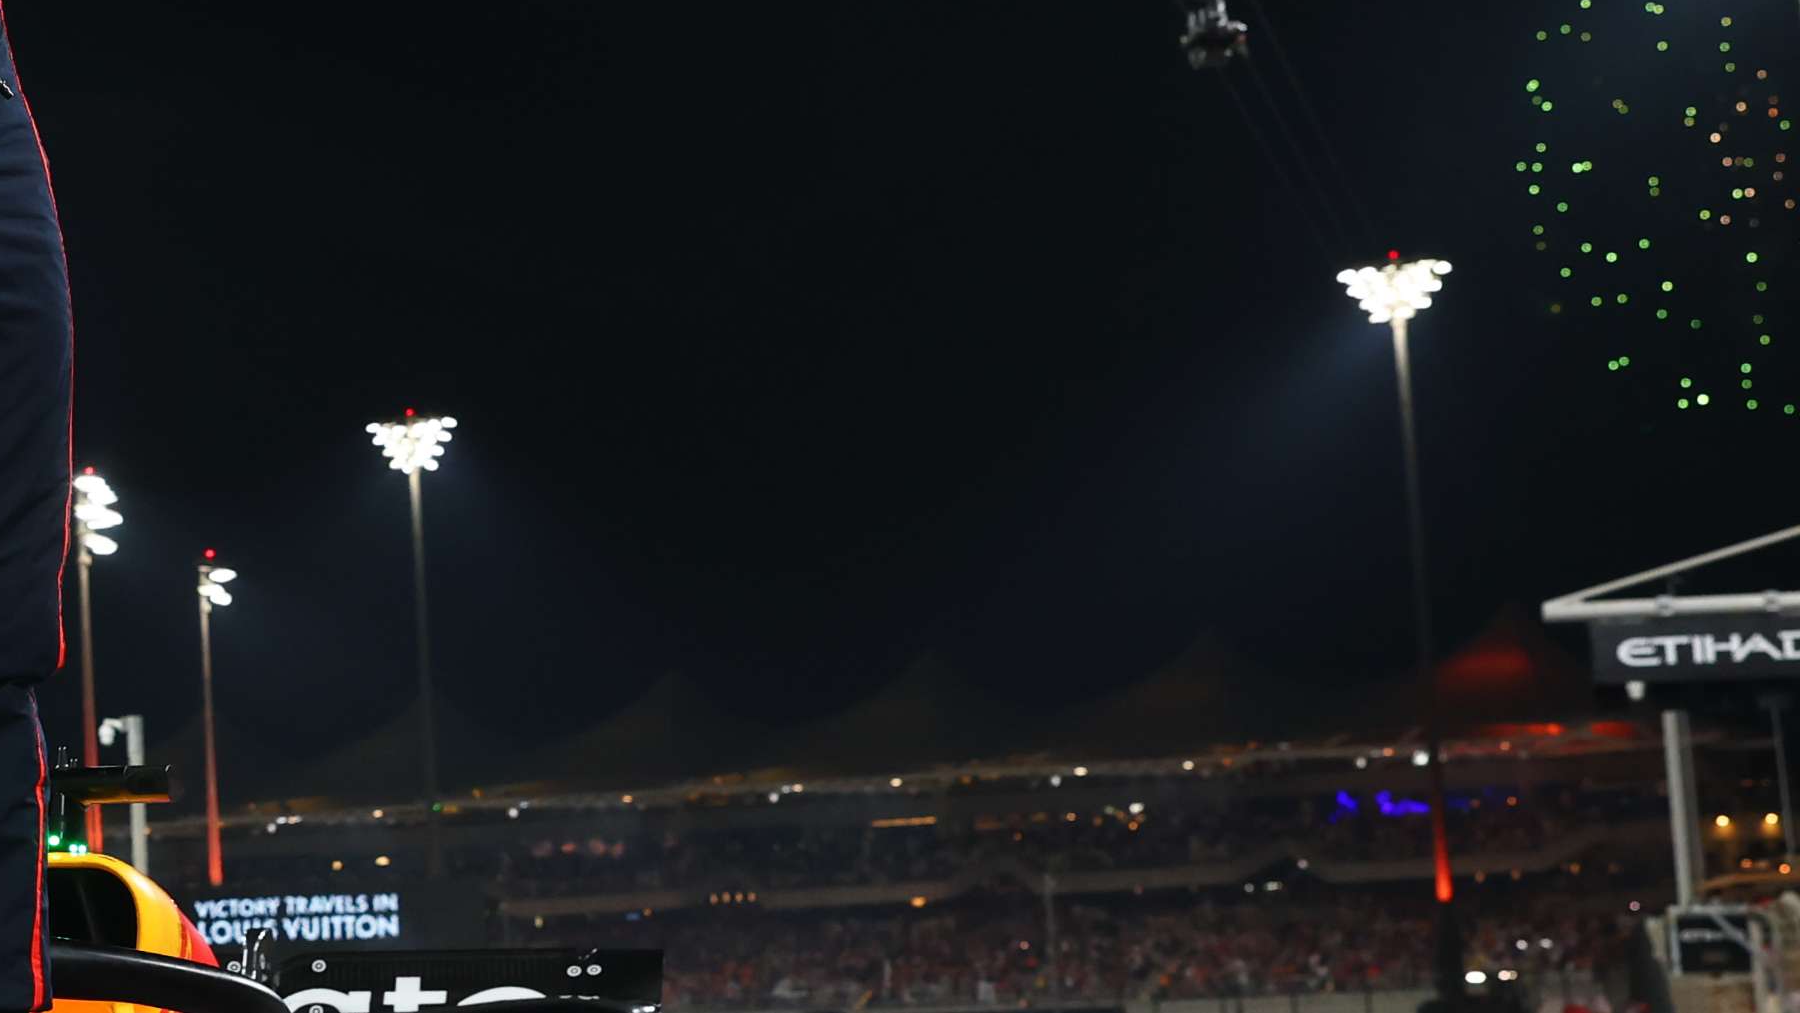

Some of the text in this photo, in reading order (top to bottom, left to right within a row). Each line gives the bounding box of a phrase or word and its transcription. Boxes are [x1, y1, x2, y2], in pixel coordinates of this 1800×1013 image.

[194, 892, 399, 918] VICTORY TRAVELS IN
[282, 914, 400, 940] VUITTON
